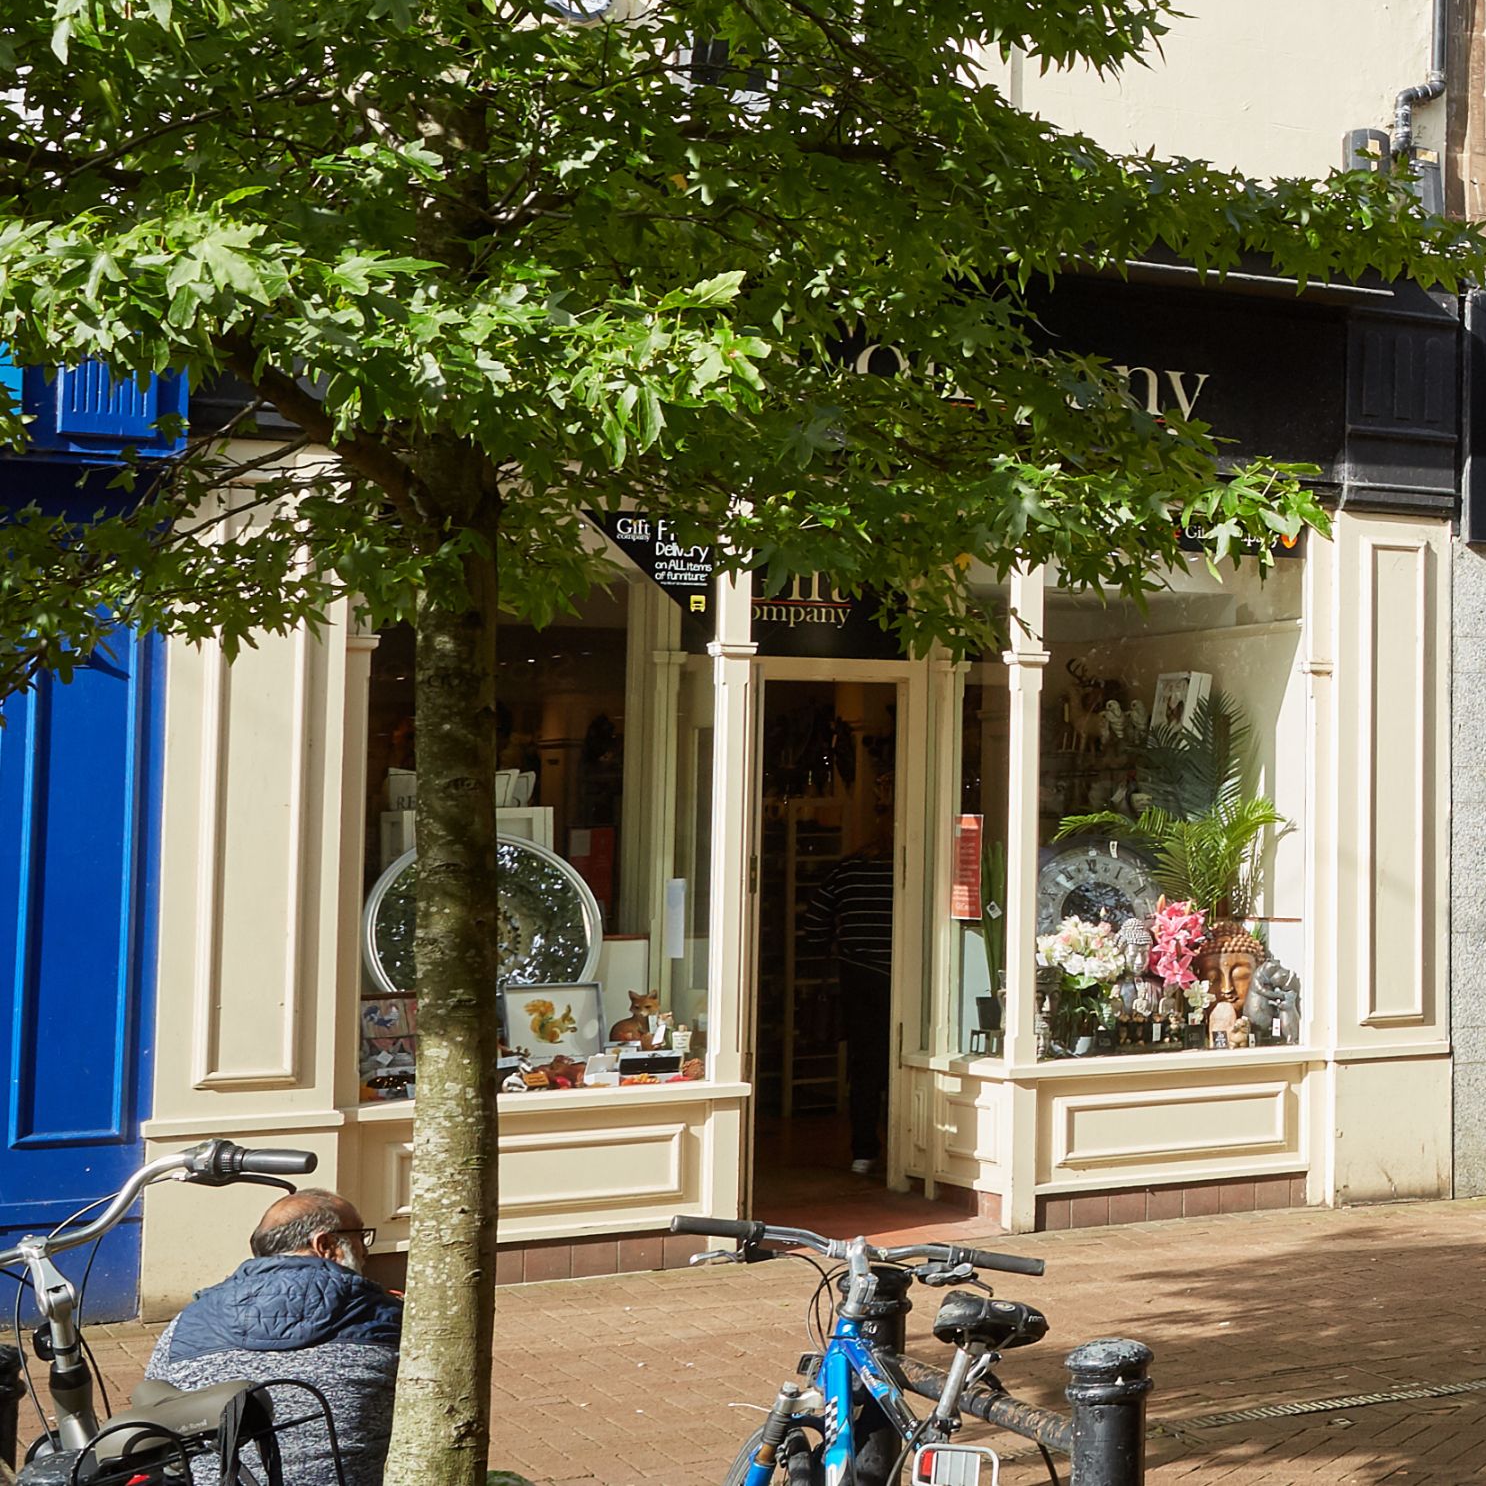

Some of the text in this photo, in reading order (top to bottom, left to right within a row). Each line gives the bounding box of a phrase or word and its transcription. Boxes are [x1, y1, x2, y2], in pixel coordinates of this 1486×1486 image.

[616, 517, 650, 535] Gift
[655, 561, 667, 570] on
[668, 559, 686, 570] ALL
[751, 603, 851, 628] ompany
